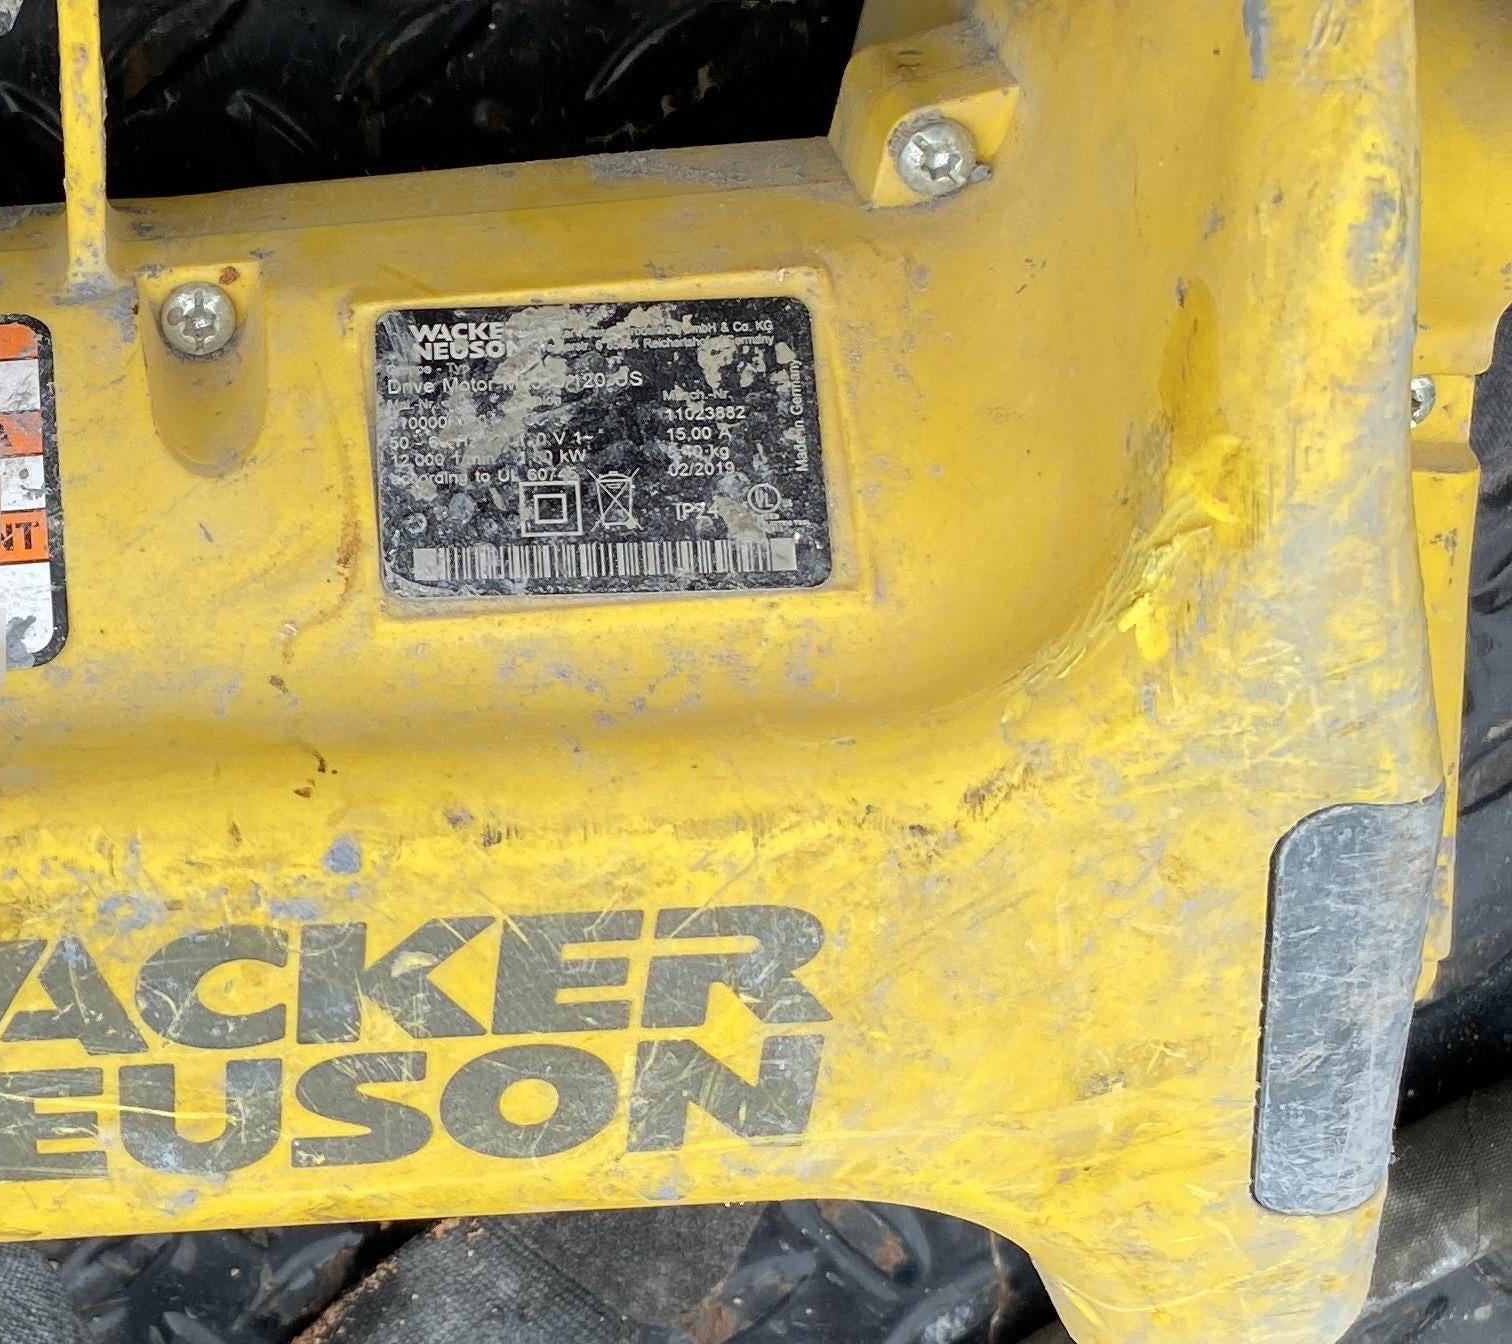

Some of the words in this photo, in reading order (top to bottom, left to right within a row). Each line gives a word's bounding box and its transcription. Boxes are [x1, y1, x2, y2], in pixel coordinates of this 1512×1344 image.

[408, 321, 506, 343] WACKE
[755, 319, 774, 331] KG
[442, 376, 494, 395] Motor
[666, 426, 712, 442] 15.00
[560, 448, 586, 463] kW
[475, 469, 491, 482] to
